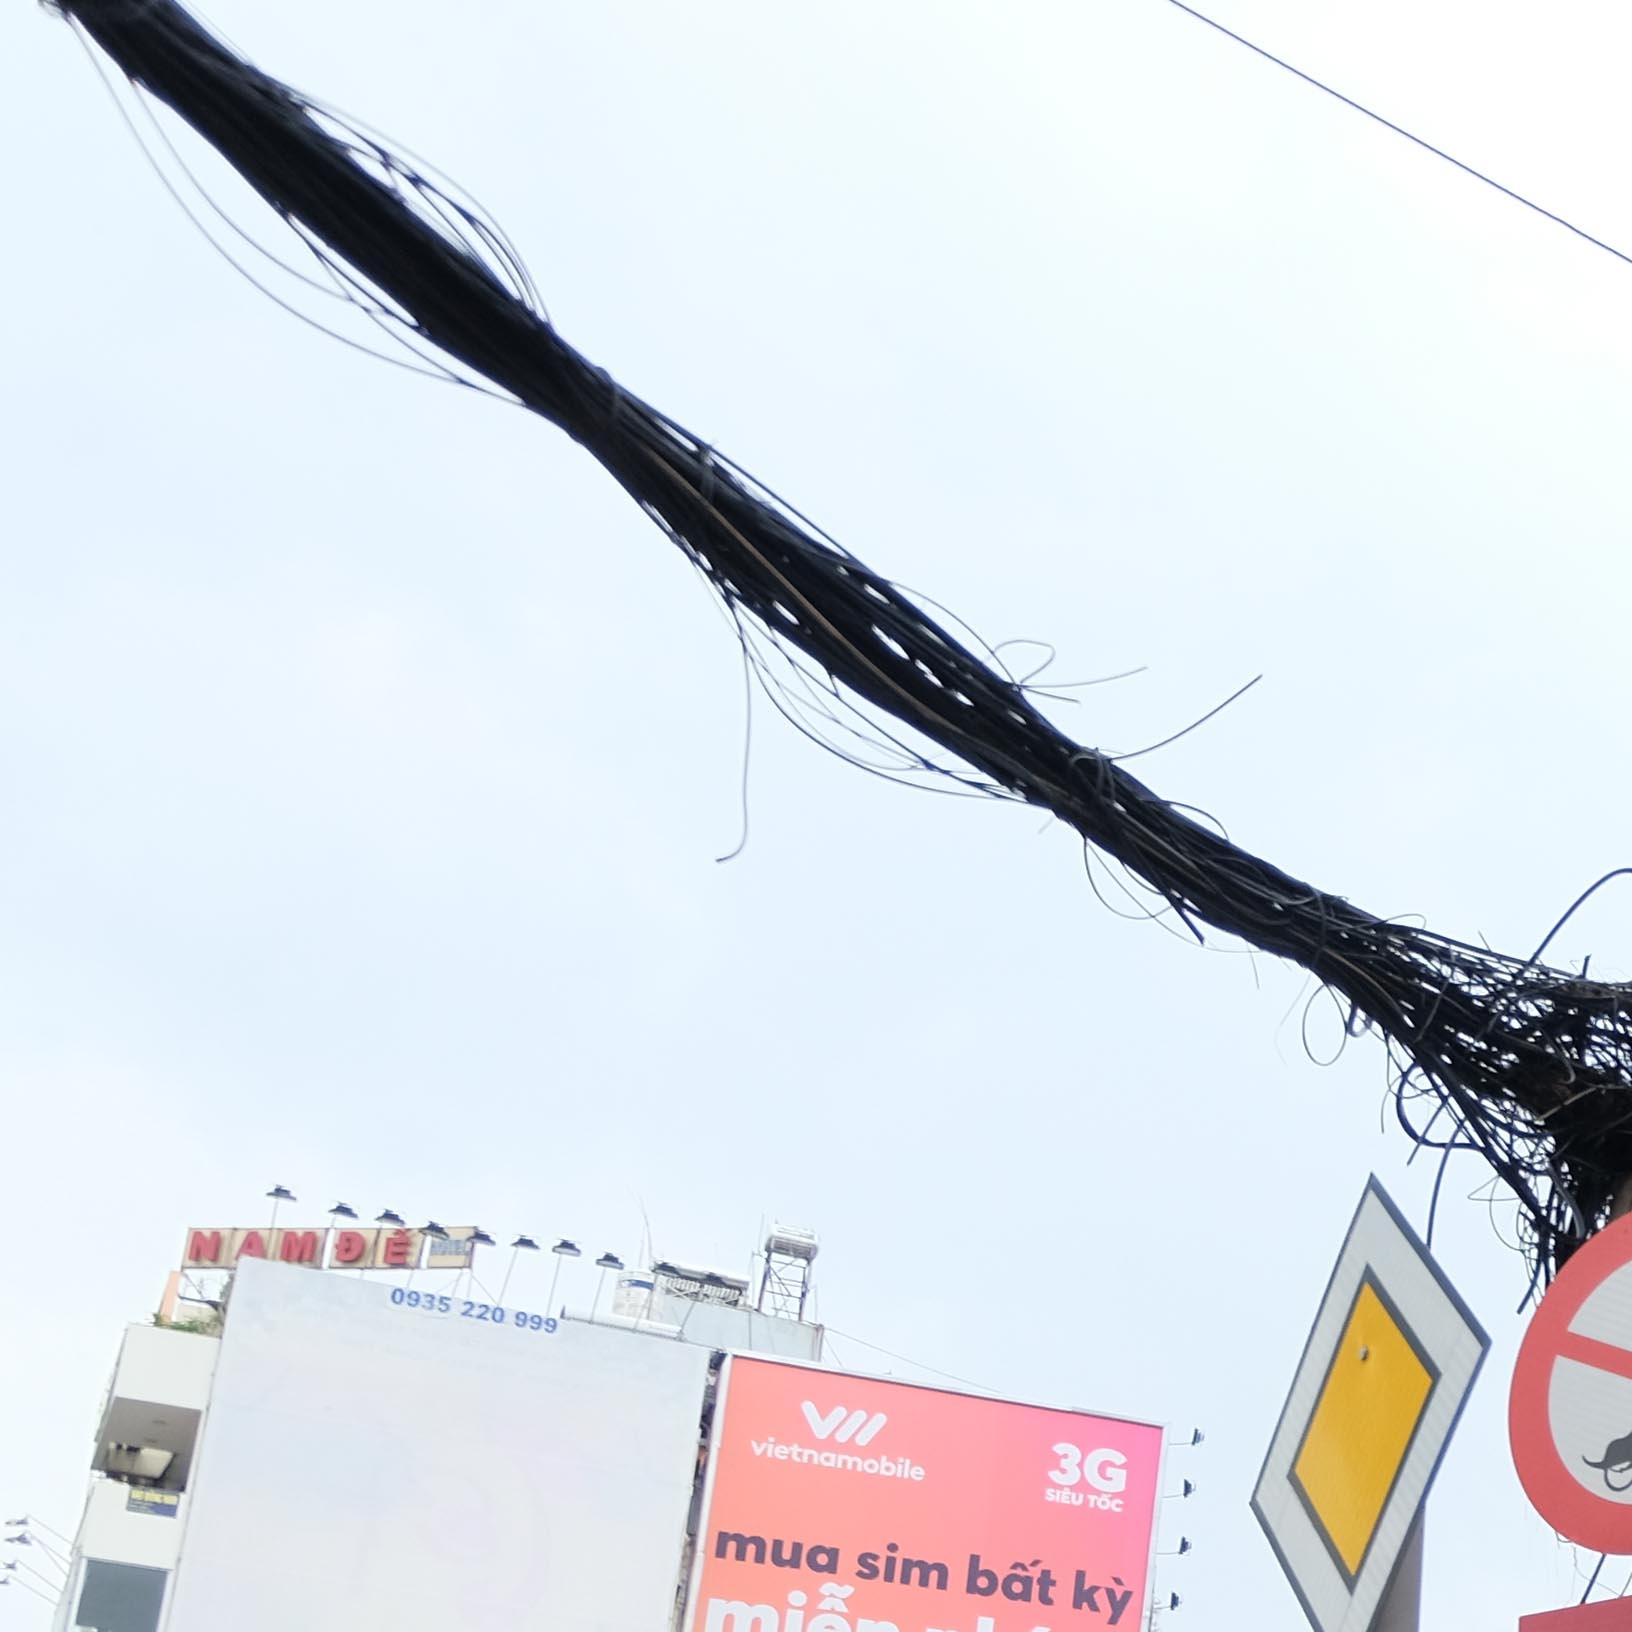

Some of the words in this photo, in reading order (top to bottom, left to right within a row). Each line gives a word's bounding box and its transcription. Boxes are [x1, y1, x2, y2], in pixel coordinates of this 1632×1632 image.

[390, 1287, 451, 1313] 0935
[460, 1300, 506, 1324] 220
[514, 1311, 559, 1334] 999
[750, 1438, 925, 1482] vietnamobile
[1048, 1442, 1128, 1494] 3G
[1045, 1486, 1083, 1508] SIÊU
[1088, 1489, 1123, 1513] TỐC
[714, 1530, 840, 1575] mua
[856, 1543, 948, 1590] sim
[965, 1554, 1056, 1606] bất
[1073, 1570, 1133, 1626] kỳ
